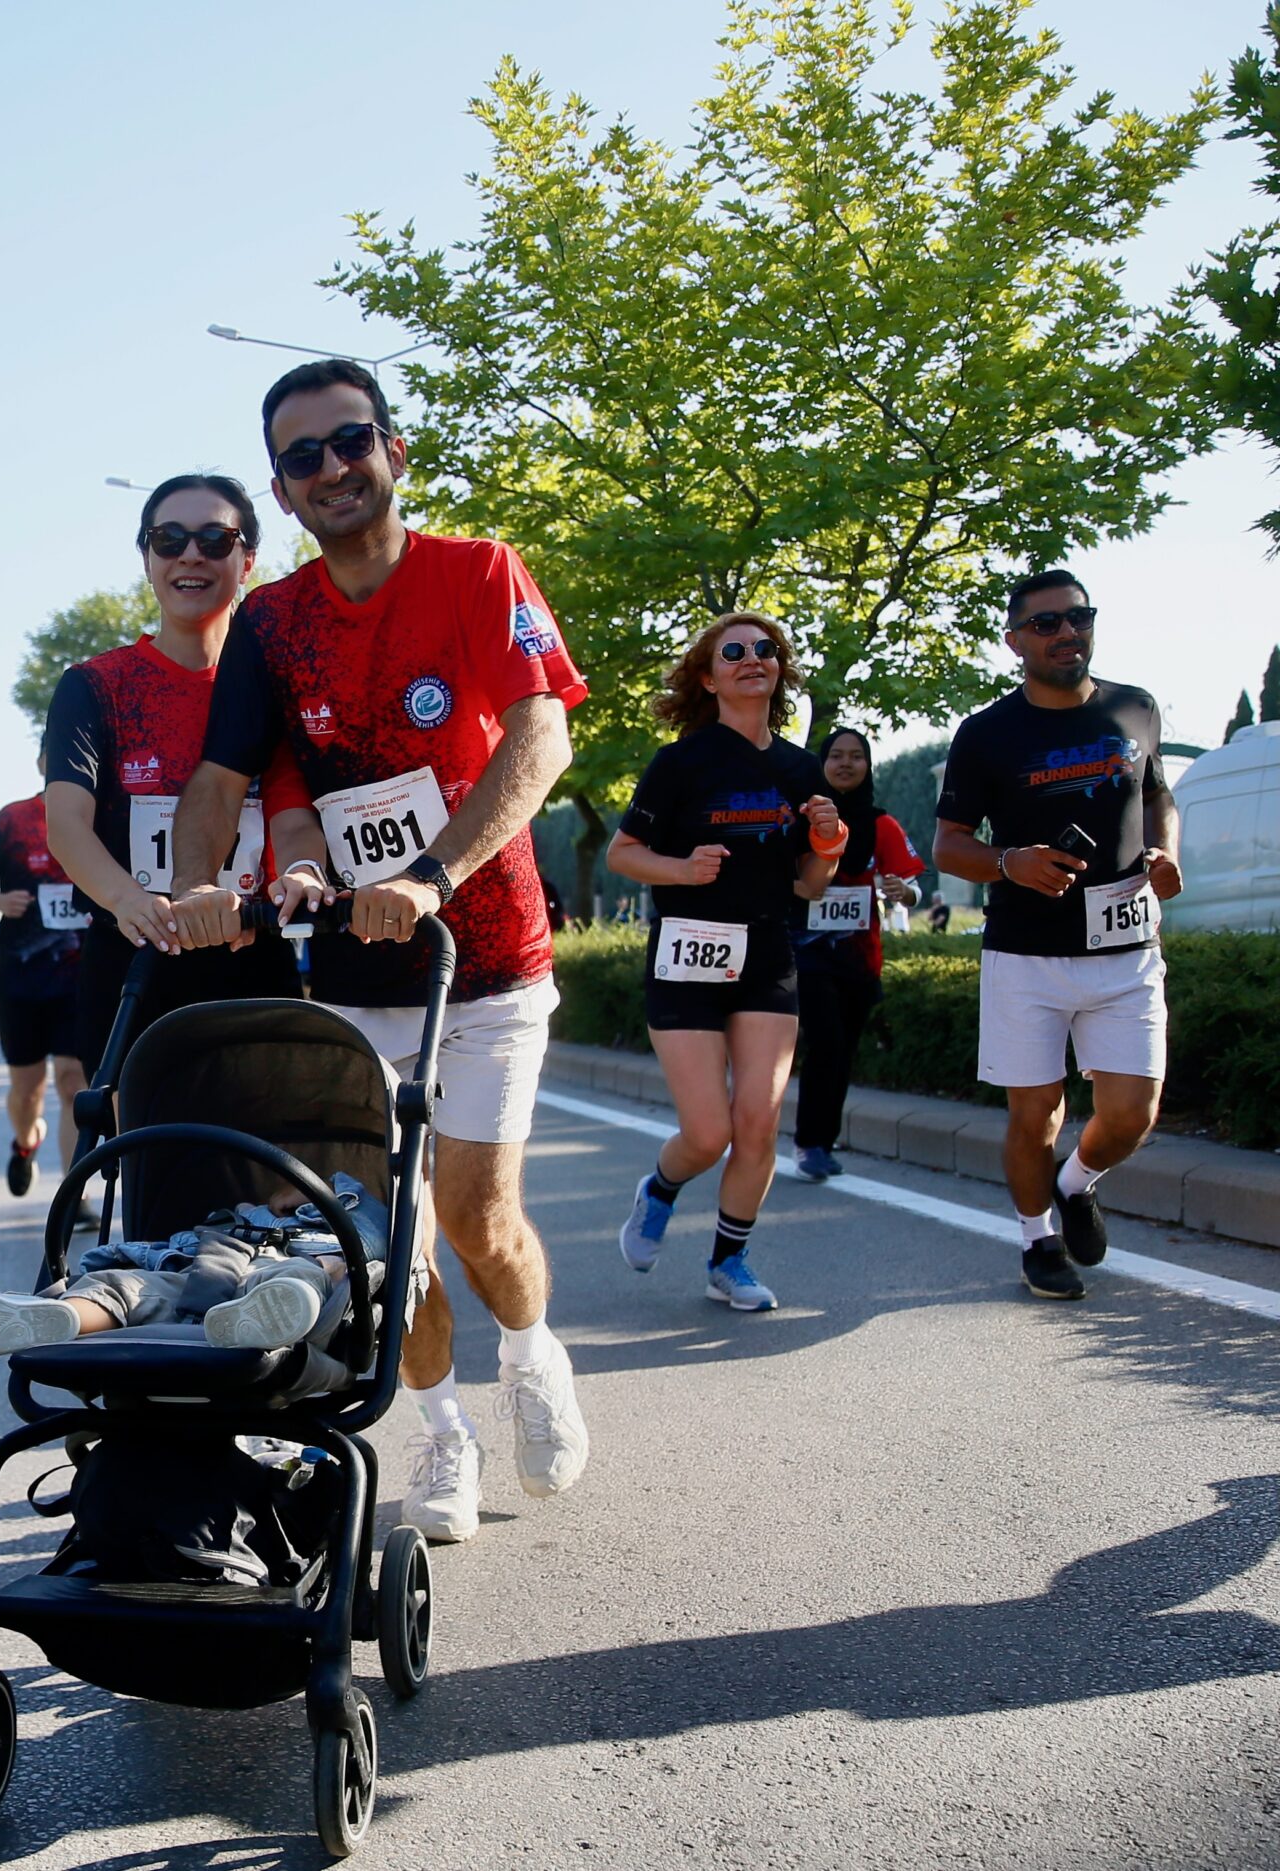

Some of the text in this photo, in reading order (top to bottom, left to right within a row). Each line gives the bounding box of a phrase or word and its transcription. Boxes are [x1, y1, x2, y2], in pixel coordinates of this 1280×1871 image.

[1029, 761, 1105, 785] RUNNING
[711, 809, 776, 824] RUNNING
[342, 809, 426, 866] 1991
[819, 901, 860, 920] 1045
[1101, 895, 1149, 932] 1587
[671, 938, 731, 969] 1382
